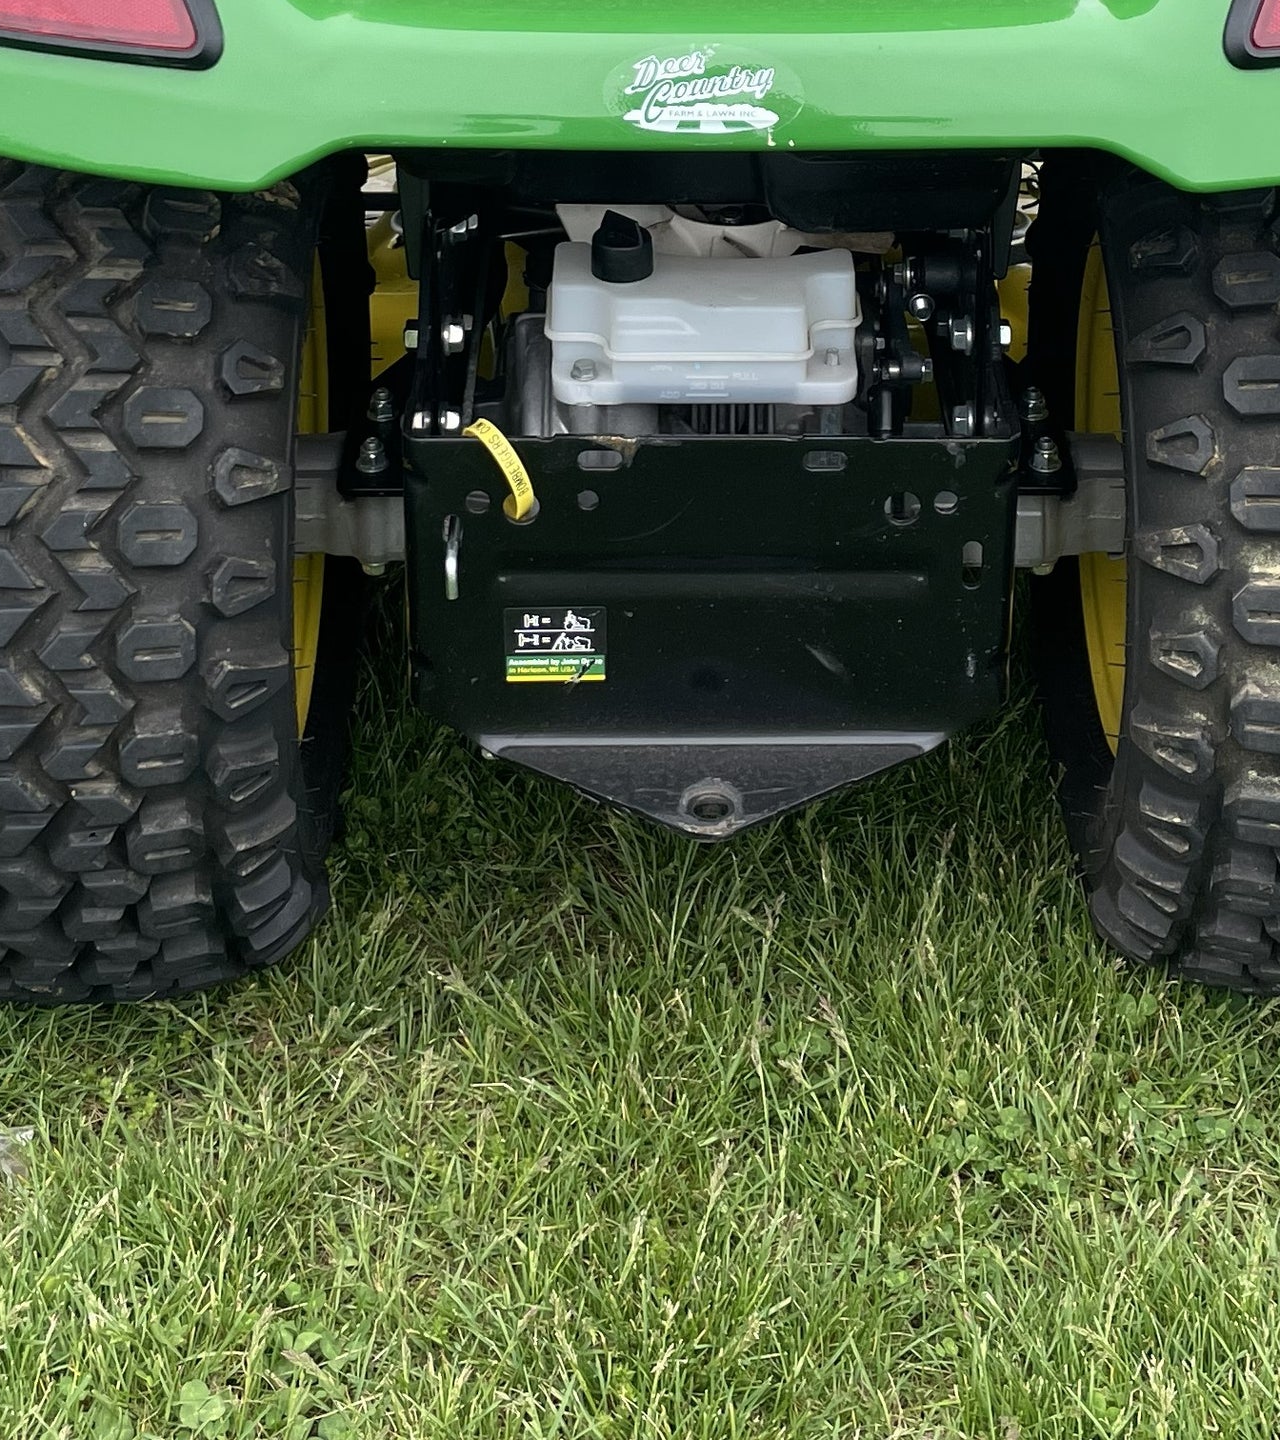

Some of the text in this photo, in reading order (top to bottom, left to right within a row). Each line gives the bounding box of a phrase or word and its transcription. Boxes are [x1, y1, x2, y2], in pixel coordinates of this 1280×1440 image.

[626, 51, 705, 93] Deer
[642, 66, 775, 125] Country
[668, 110, 696, 118] FARM
[706, 110, 736, 118] LAWN
